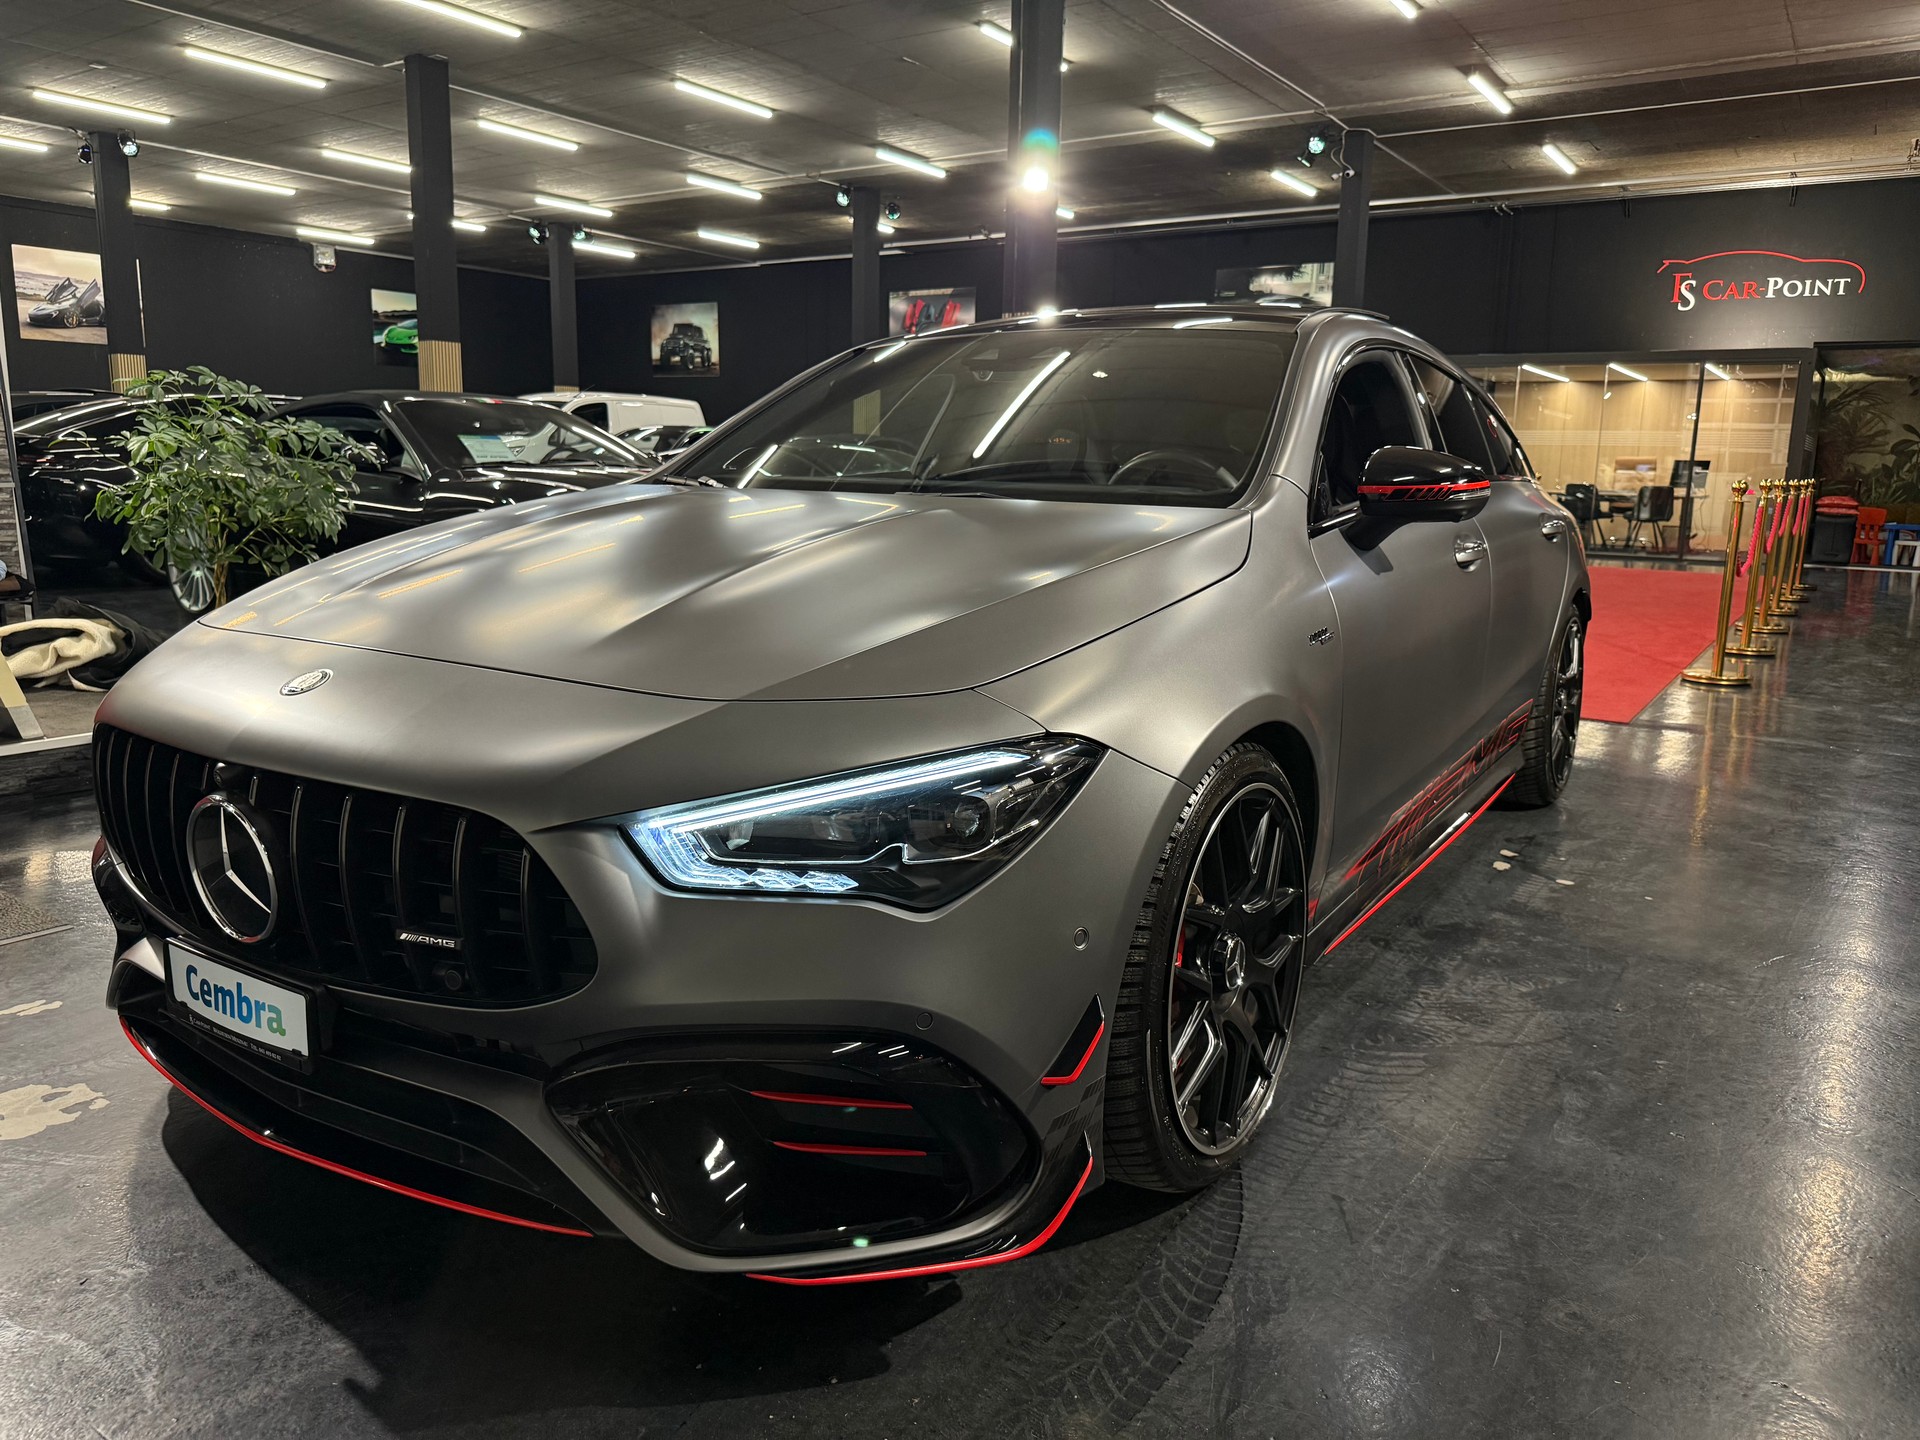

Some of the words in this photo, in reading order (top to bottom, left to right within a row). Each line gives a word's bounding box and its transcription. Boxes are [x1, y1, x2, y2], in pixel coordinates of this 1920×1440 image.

[1702, 277, 1850, 300] CAR-POINT
[416, 935, 456, 948] AMG
[186, 965, 286, 1036] Cembra
